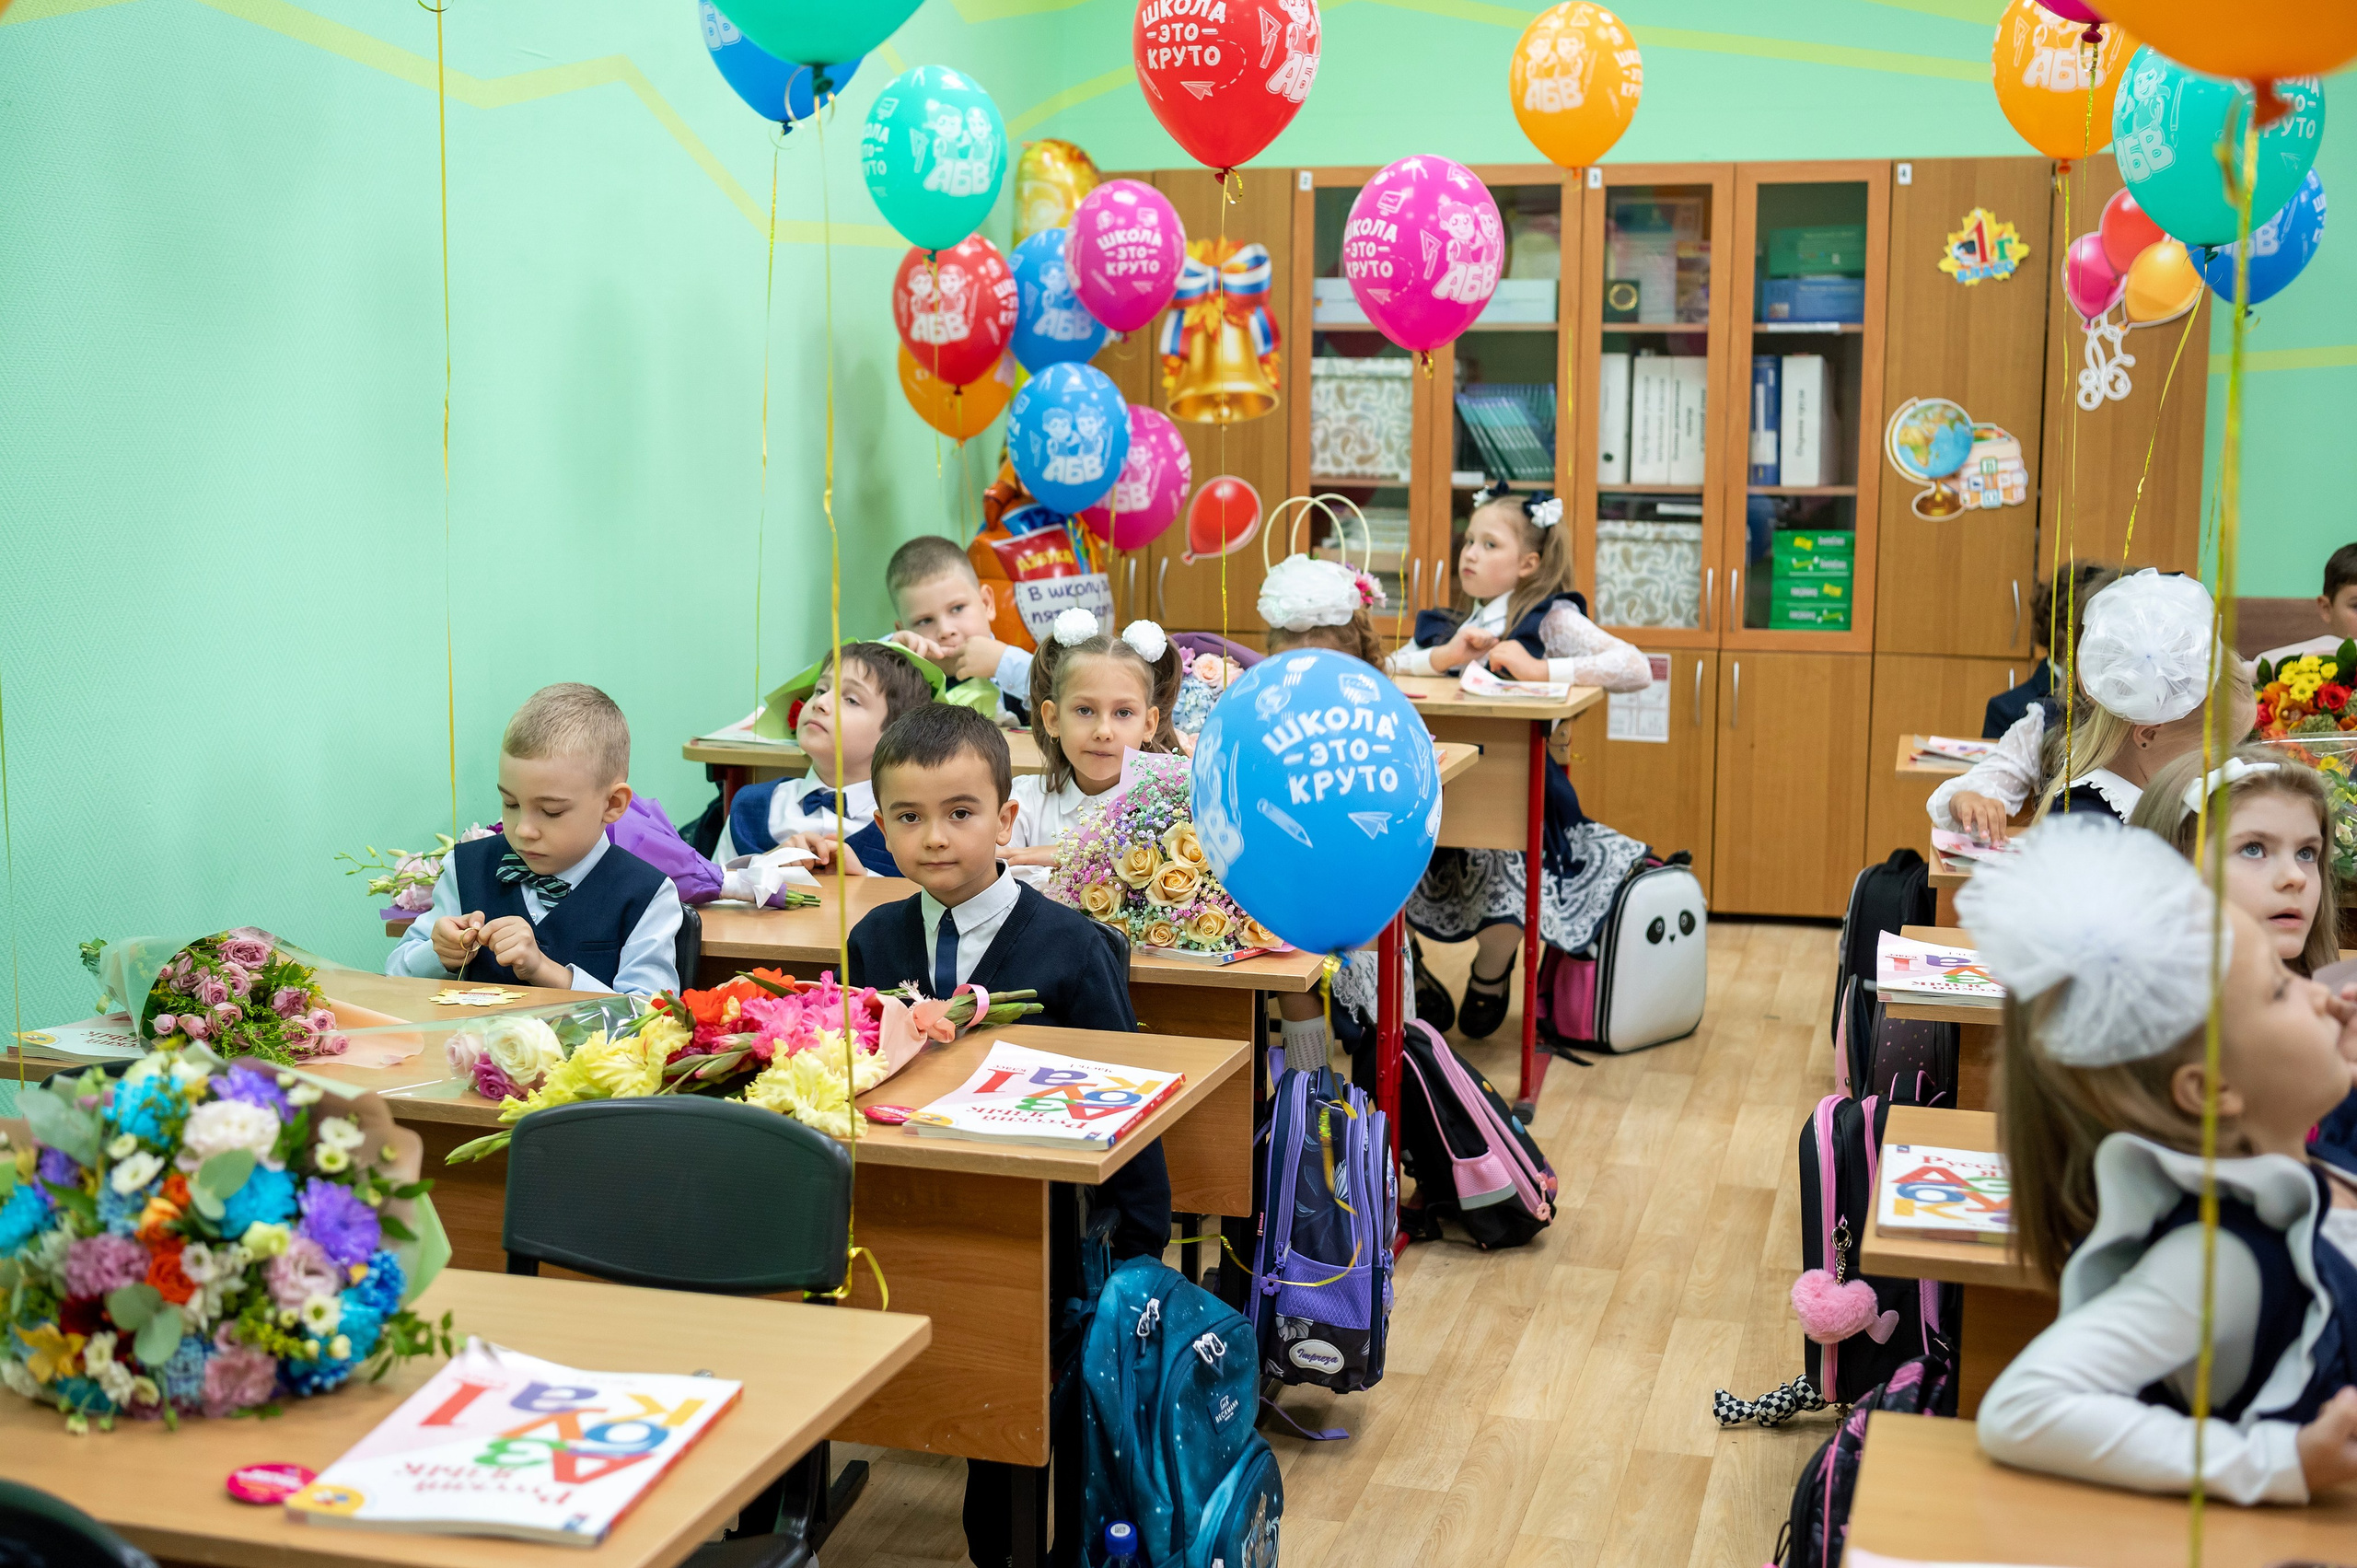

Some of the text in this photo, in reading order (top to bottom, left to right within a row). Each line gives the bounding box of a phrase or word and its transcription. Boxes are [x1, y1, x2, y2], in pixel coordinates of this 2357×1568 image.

[1141, 0, 1227, 29] ШКОЛА
[1147, 45, 1222, 70] КРУТО
[2022, 46, 2107, 93] АБВ
[1265, 51, 1321, 103] АБ
[1524, 77, 1585, 113] АБВ
[923, 157, 992, 197] АБВ
[1096, 227, 1163, 251] ШКОЛА
[1344, 217, 1399, 243] ШКОЛА
[1106, 260, 1160, 276] КРУТО
[1346, 260, 1394, 279] КРУТО
[1432, 263, 1499, 304] АБВ
[910, 311, 970, 344] АБВ
[1032, 308, 1093, 342] АБВ
[1042, 455, 1104, 485] АБВ
[1261, 706, 1397, 756] ШКОЛА
[1288, 765, 1399, 806] КРУТО
[980, 1115, 1088, 1130] Русский
[1296, 1348, 1339, 1365] Impreza
[1215, 1399, 1239, 1423] BECKMANN
